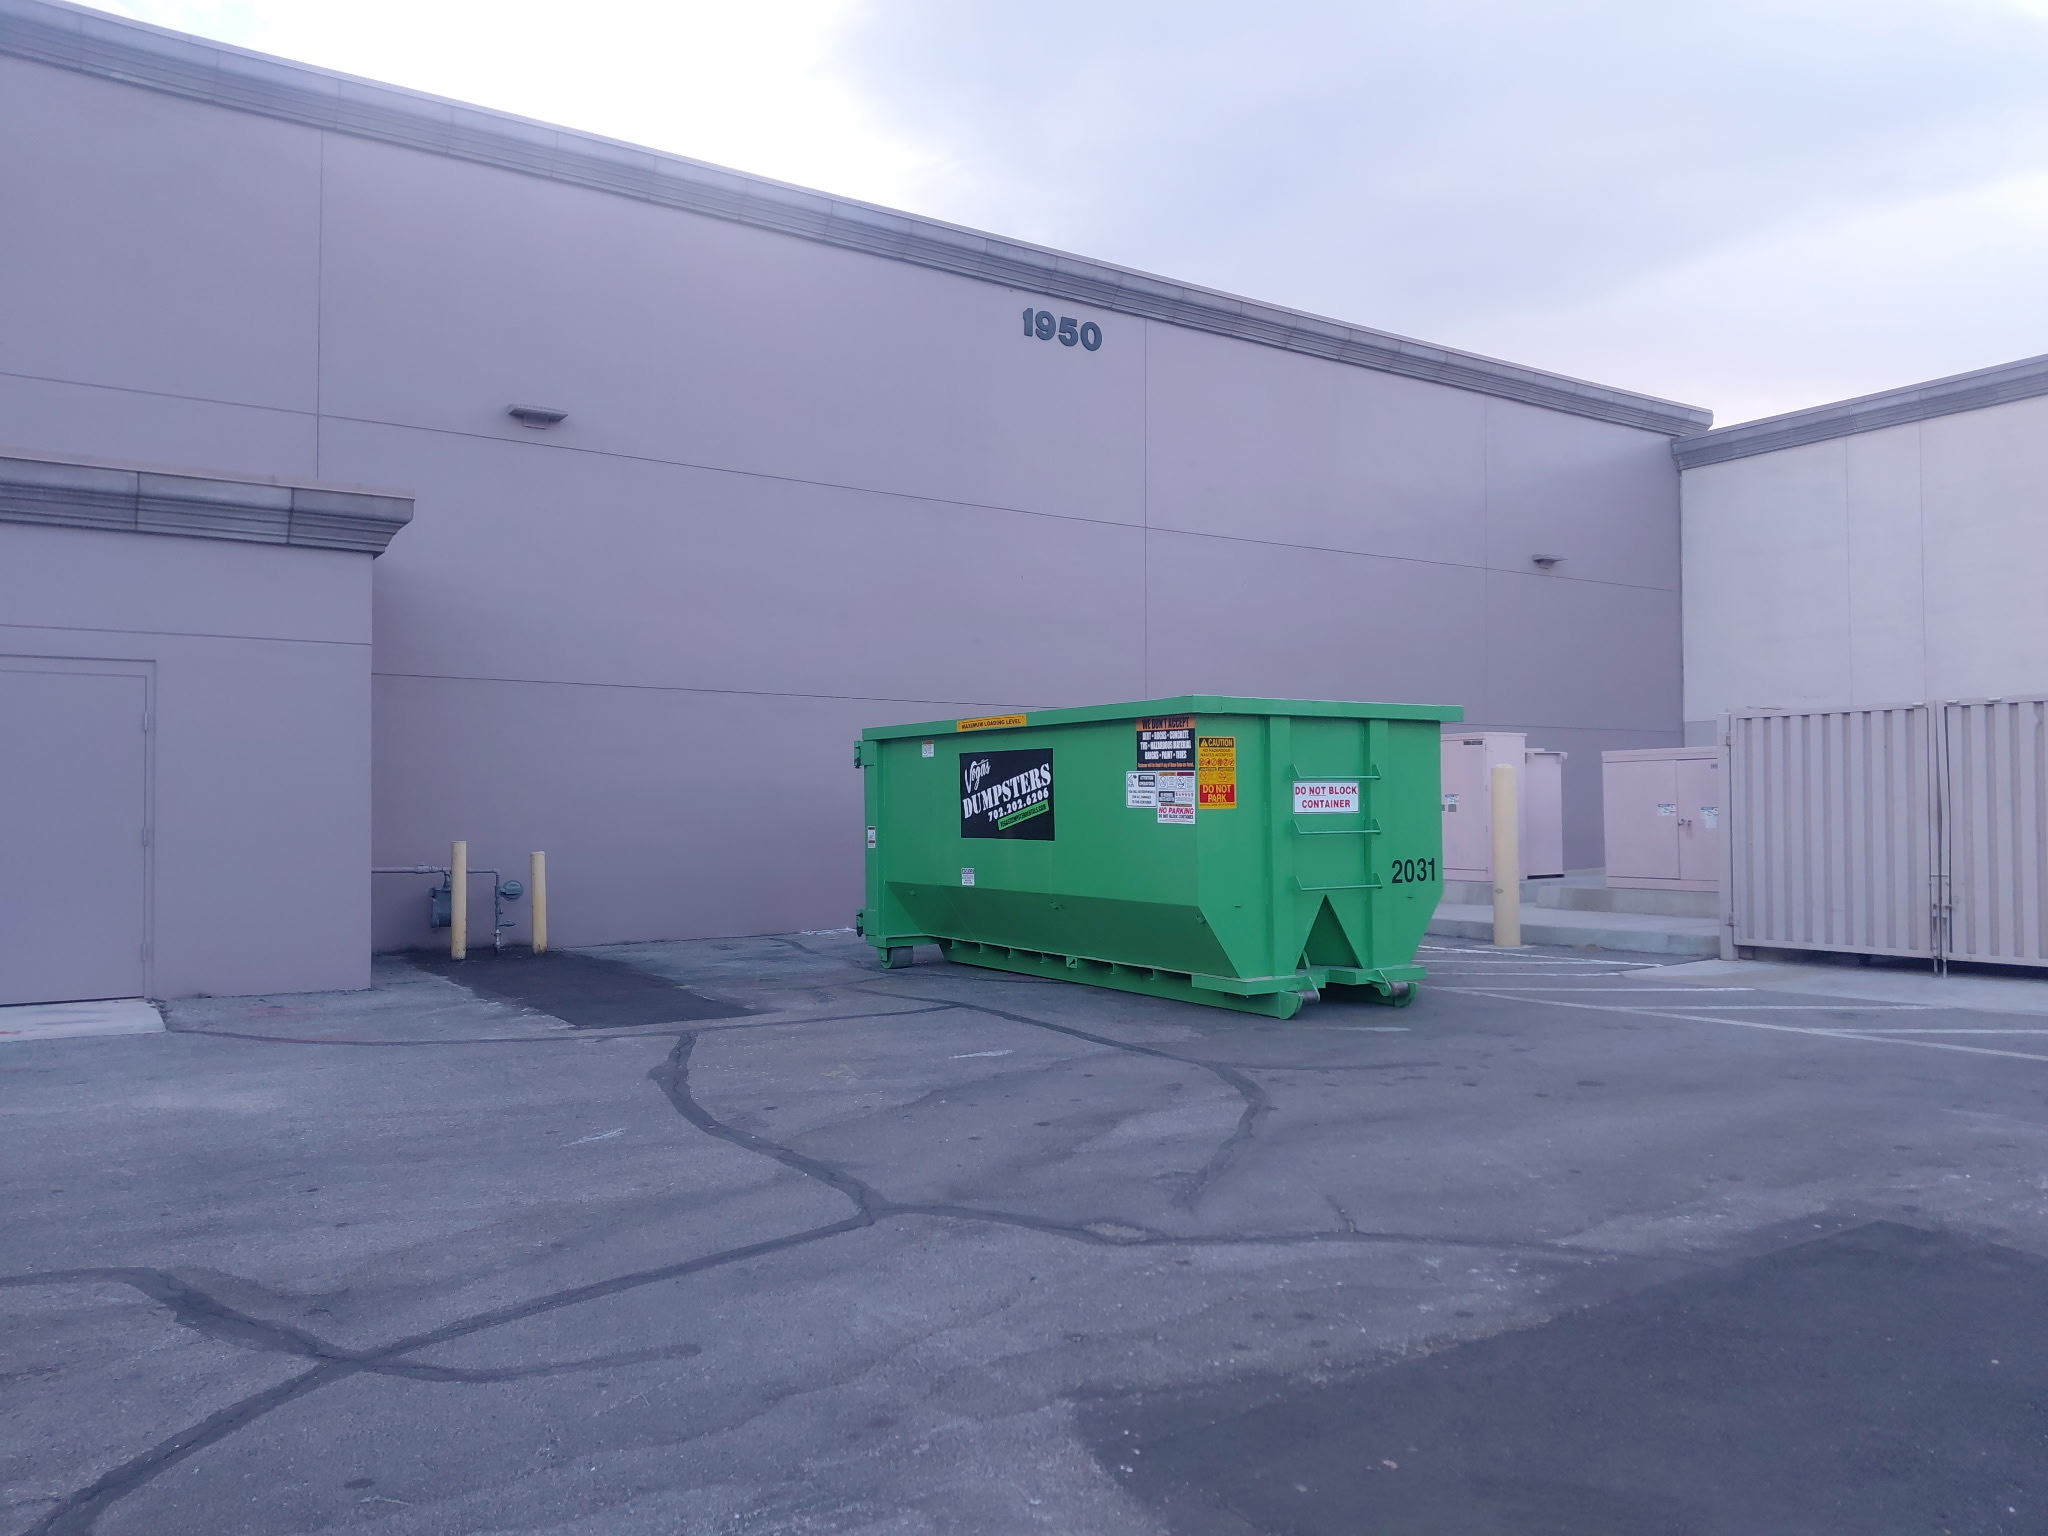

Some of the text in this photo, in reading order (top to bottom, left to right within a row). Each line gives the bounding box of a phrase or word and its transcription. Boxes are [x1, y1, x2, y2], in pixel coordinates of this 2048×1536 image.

[1023, 307, 1103, 352] 1950
[961, 721, 984, 730] MAXIMUM
[984, 719, 1005, 727] LOADING
[1142, 716, 1190, 730] WE DON'T ACCEPT
[1208, 738, 1233, 747] CAUTION
[964, 758, 992, 794] Vegas
[962, 762, 1052, 819] DUMPSTERS
[1202, 784, 1232, 794] DO NOT
[1295, 786, 1358, 796] DO NOT BLOCK
[1208, 794, 1227, 802] PARK
[1302, 799, 1351, 808] CONTAINER
[988, 788, 1050, 822] 702.202.6206
[1392, 858, 1436, 884] 2031
